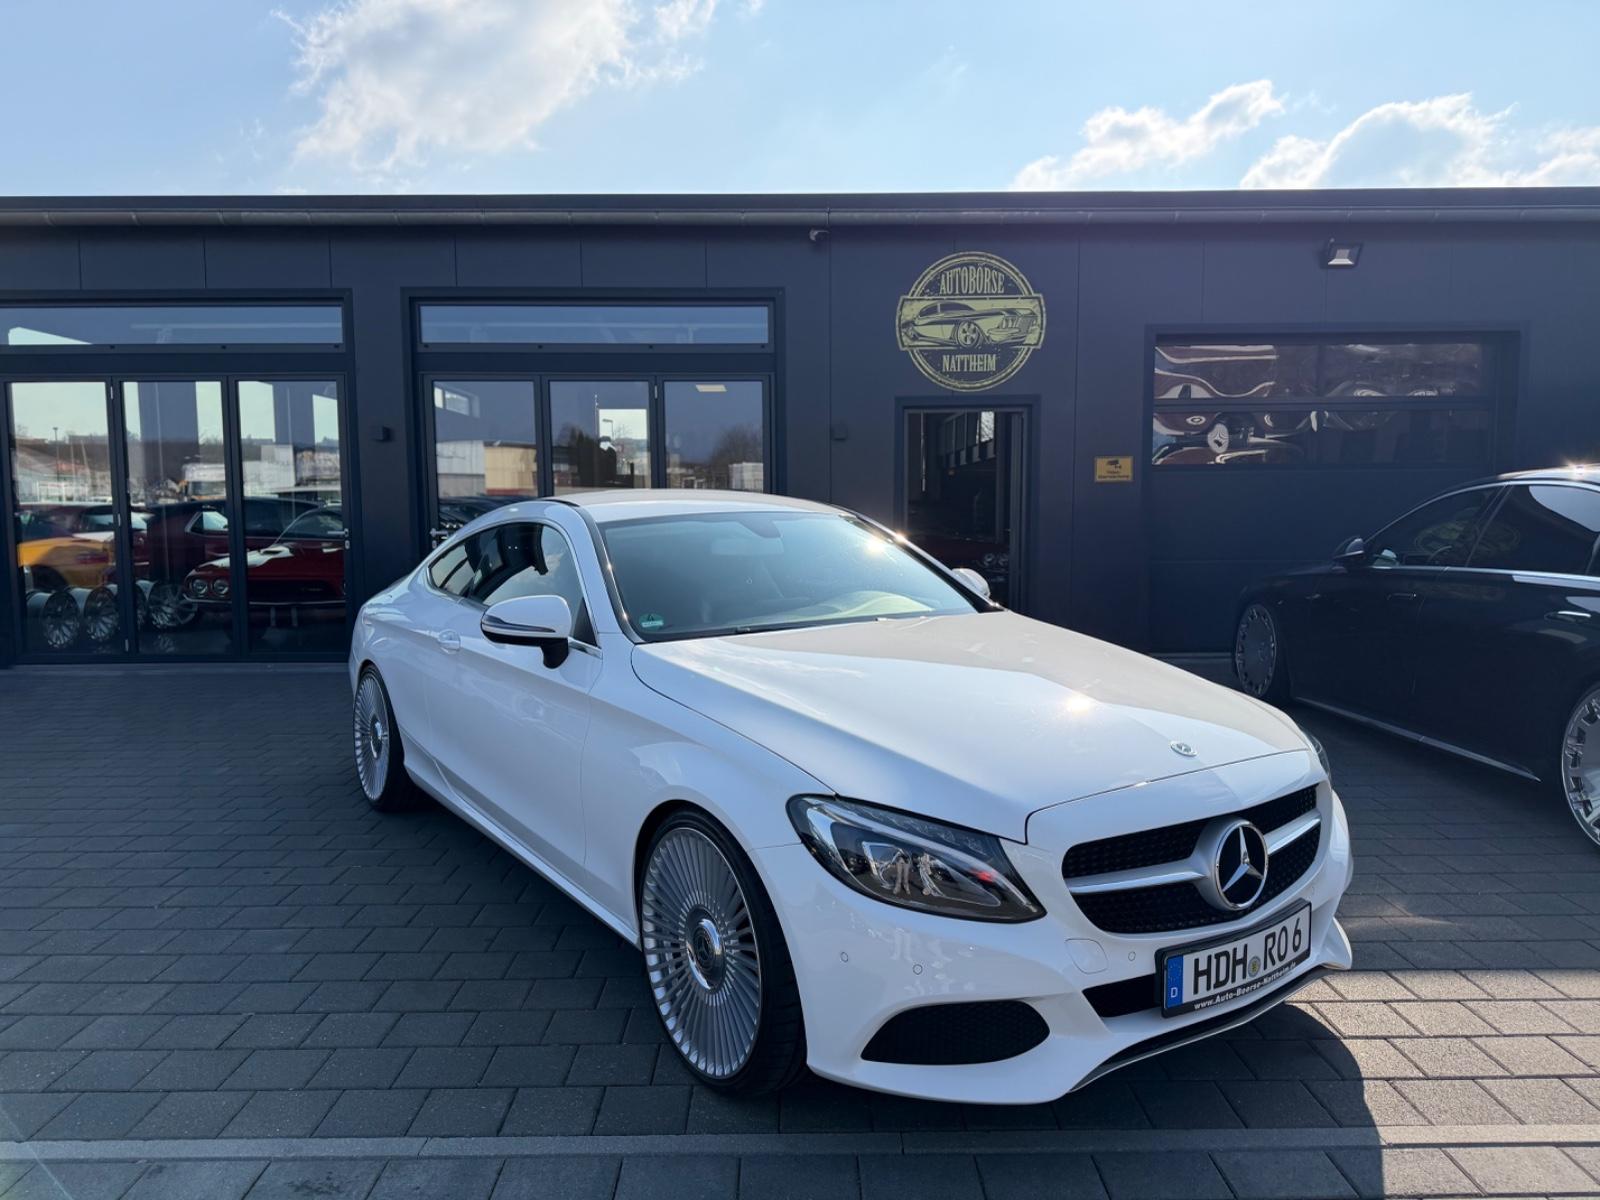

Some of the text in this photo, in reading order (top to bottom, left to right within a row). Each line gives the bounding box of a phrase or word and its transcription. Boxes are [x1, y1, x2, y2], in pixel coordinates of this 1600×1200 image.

[940, 263, 1005, 294] AUTOBÖRSE
[942, 353, 997, 373] NATTHEIM
[1193, 917, 1302, 996] HDH RO 6
[1170, 987, 1179, 999] D
